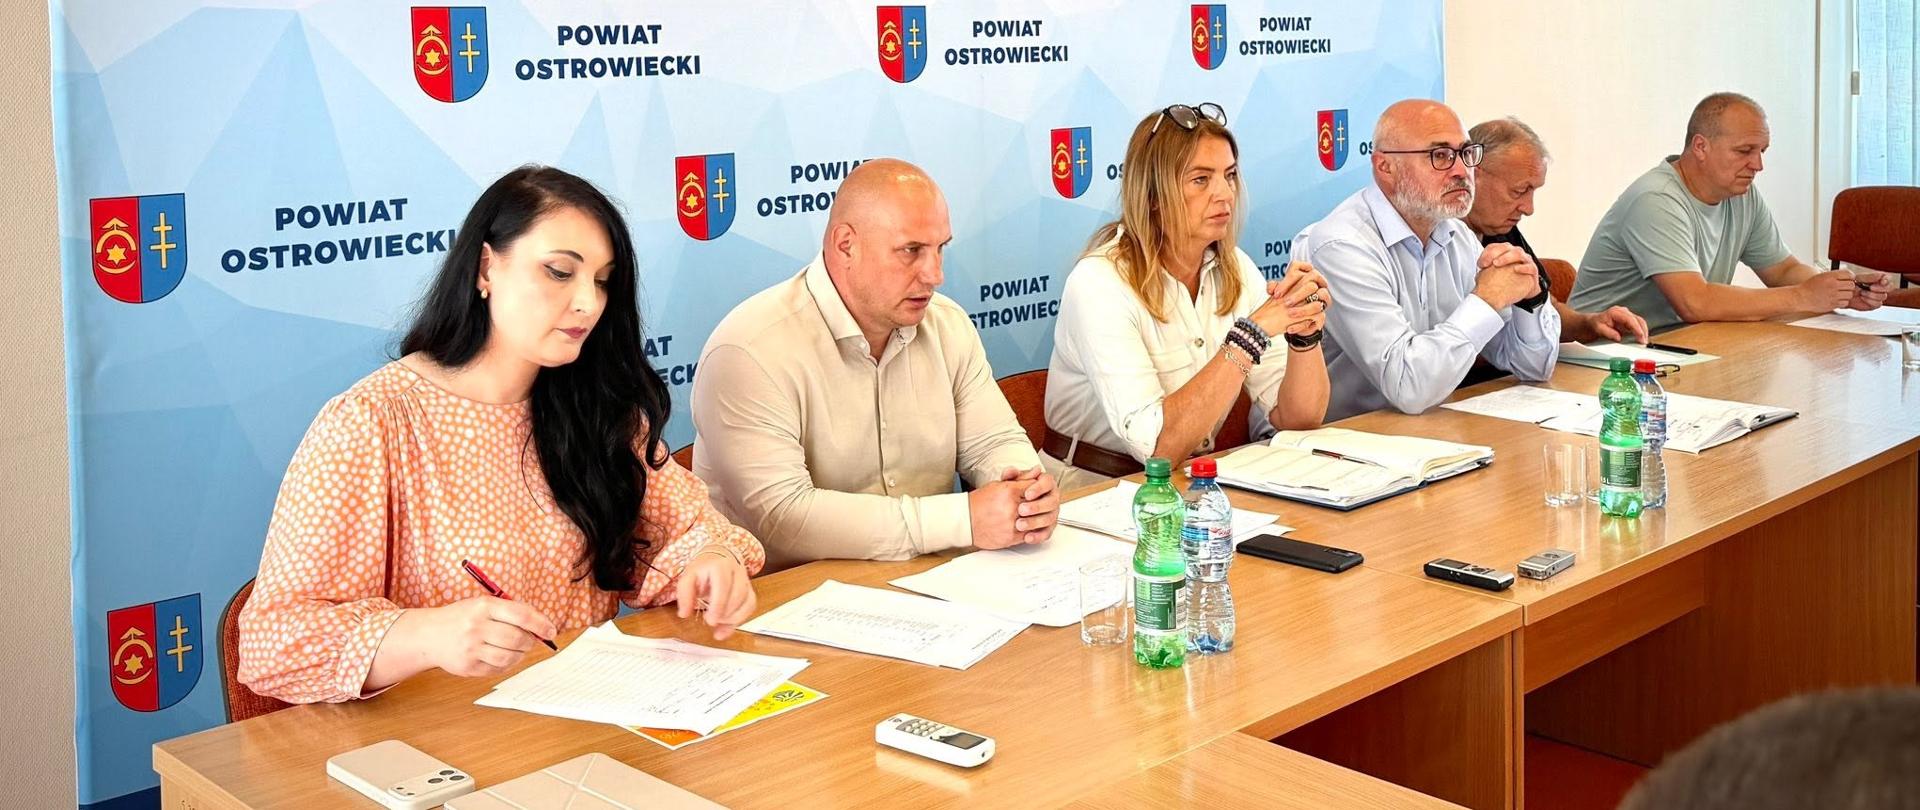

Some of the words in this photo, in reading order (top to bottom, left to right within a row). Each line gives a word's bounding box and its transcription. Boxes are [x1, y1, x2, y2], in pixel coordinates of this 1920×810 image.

[557, 24, 662, 46] POWIAT
[972, 20, 1043, 38] POWIAT
[1259, 16, 1312, 32] POWIAT
[944, 45, 1069, 65] OSTROWIECKI
[1239, 38, 1332, 56] OSTROWIECKI
[515, 55, 701, 81] OSTROWIECKI
[791, 158, 873, 184] POWI
[275, 198, 408, 231] POWIAT
[980, 275, 1049, 302] POWIAT
[968, 298, 1062, 329] STROWIEC
